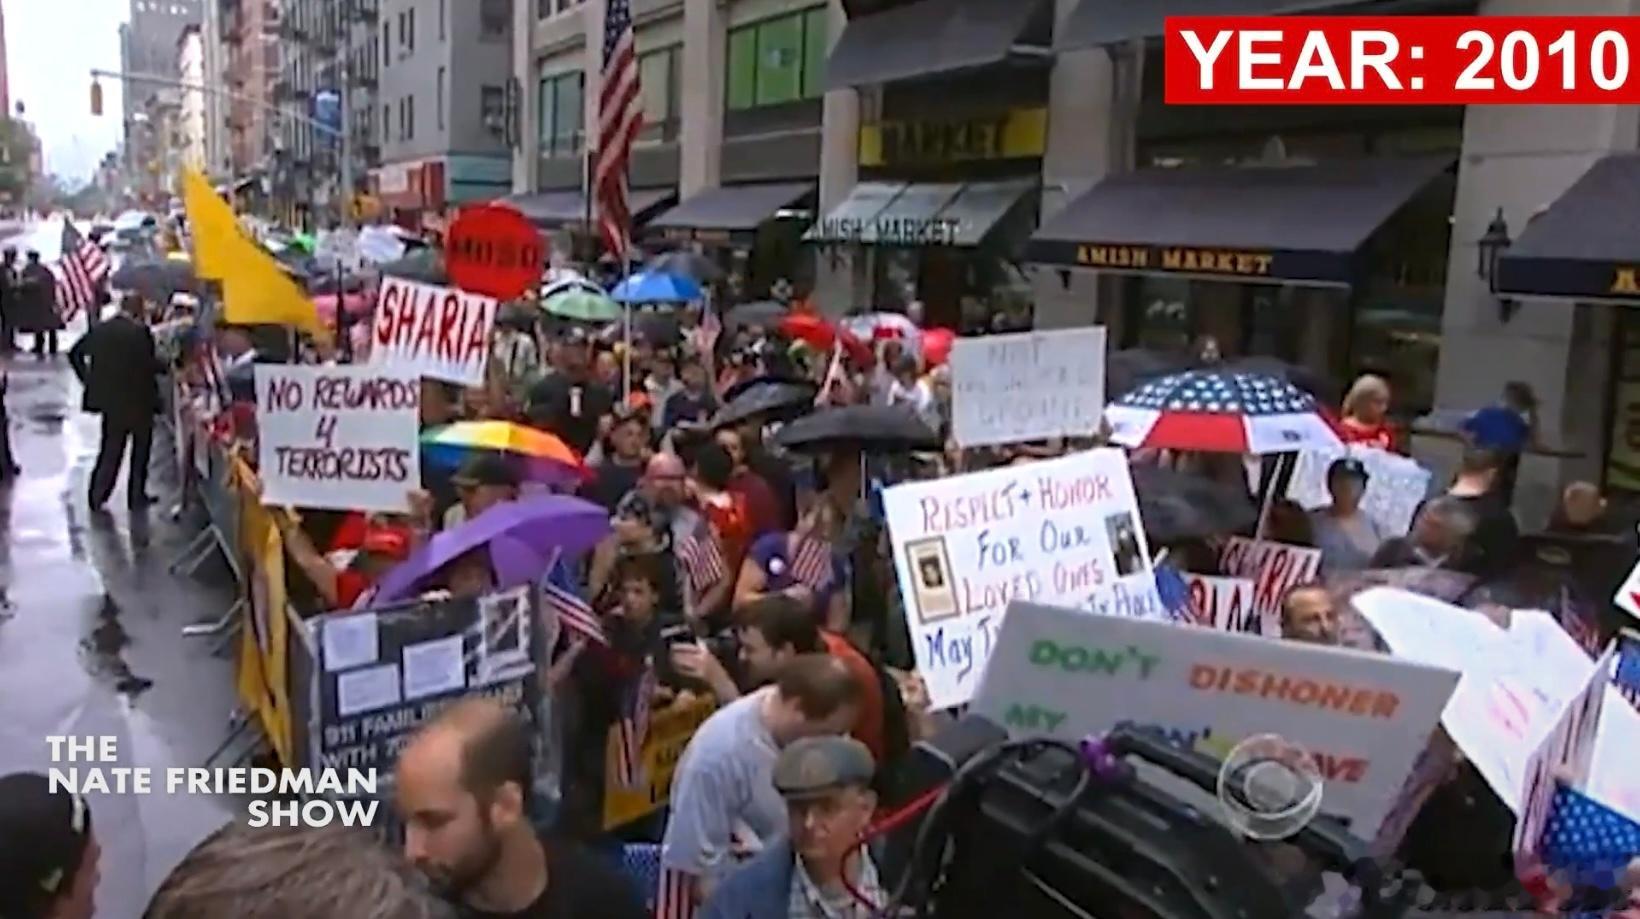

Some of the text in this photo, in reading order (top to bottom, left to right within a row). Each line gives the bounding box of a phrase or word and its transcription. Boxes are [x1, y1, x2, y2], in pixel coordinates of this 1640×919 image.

[1077, 243, 1274, 275] AMISH MARKET
[378, 283, 487, 364] SHARIA
[266, 375, 420, 414] NO REWARDS
[315, 414, 338, 448] 4
[275, 446, 410, 482] TERRORISTS
[1038, 474, 1115, 513] HONOR
[1029, 638, 1160, 679] DON'T
[1189, 662, 1401, 720] DISHONER
[1005, 704, 1067, 732] MY
